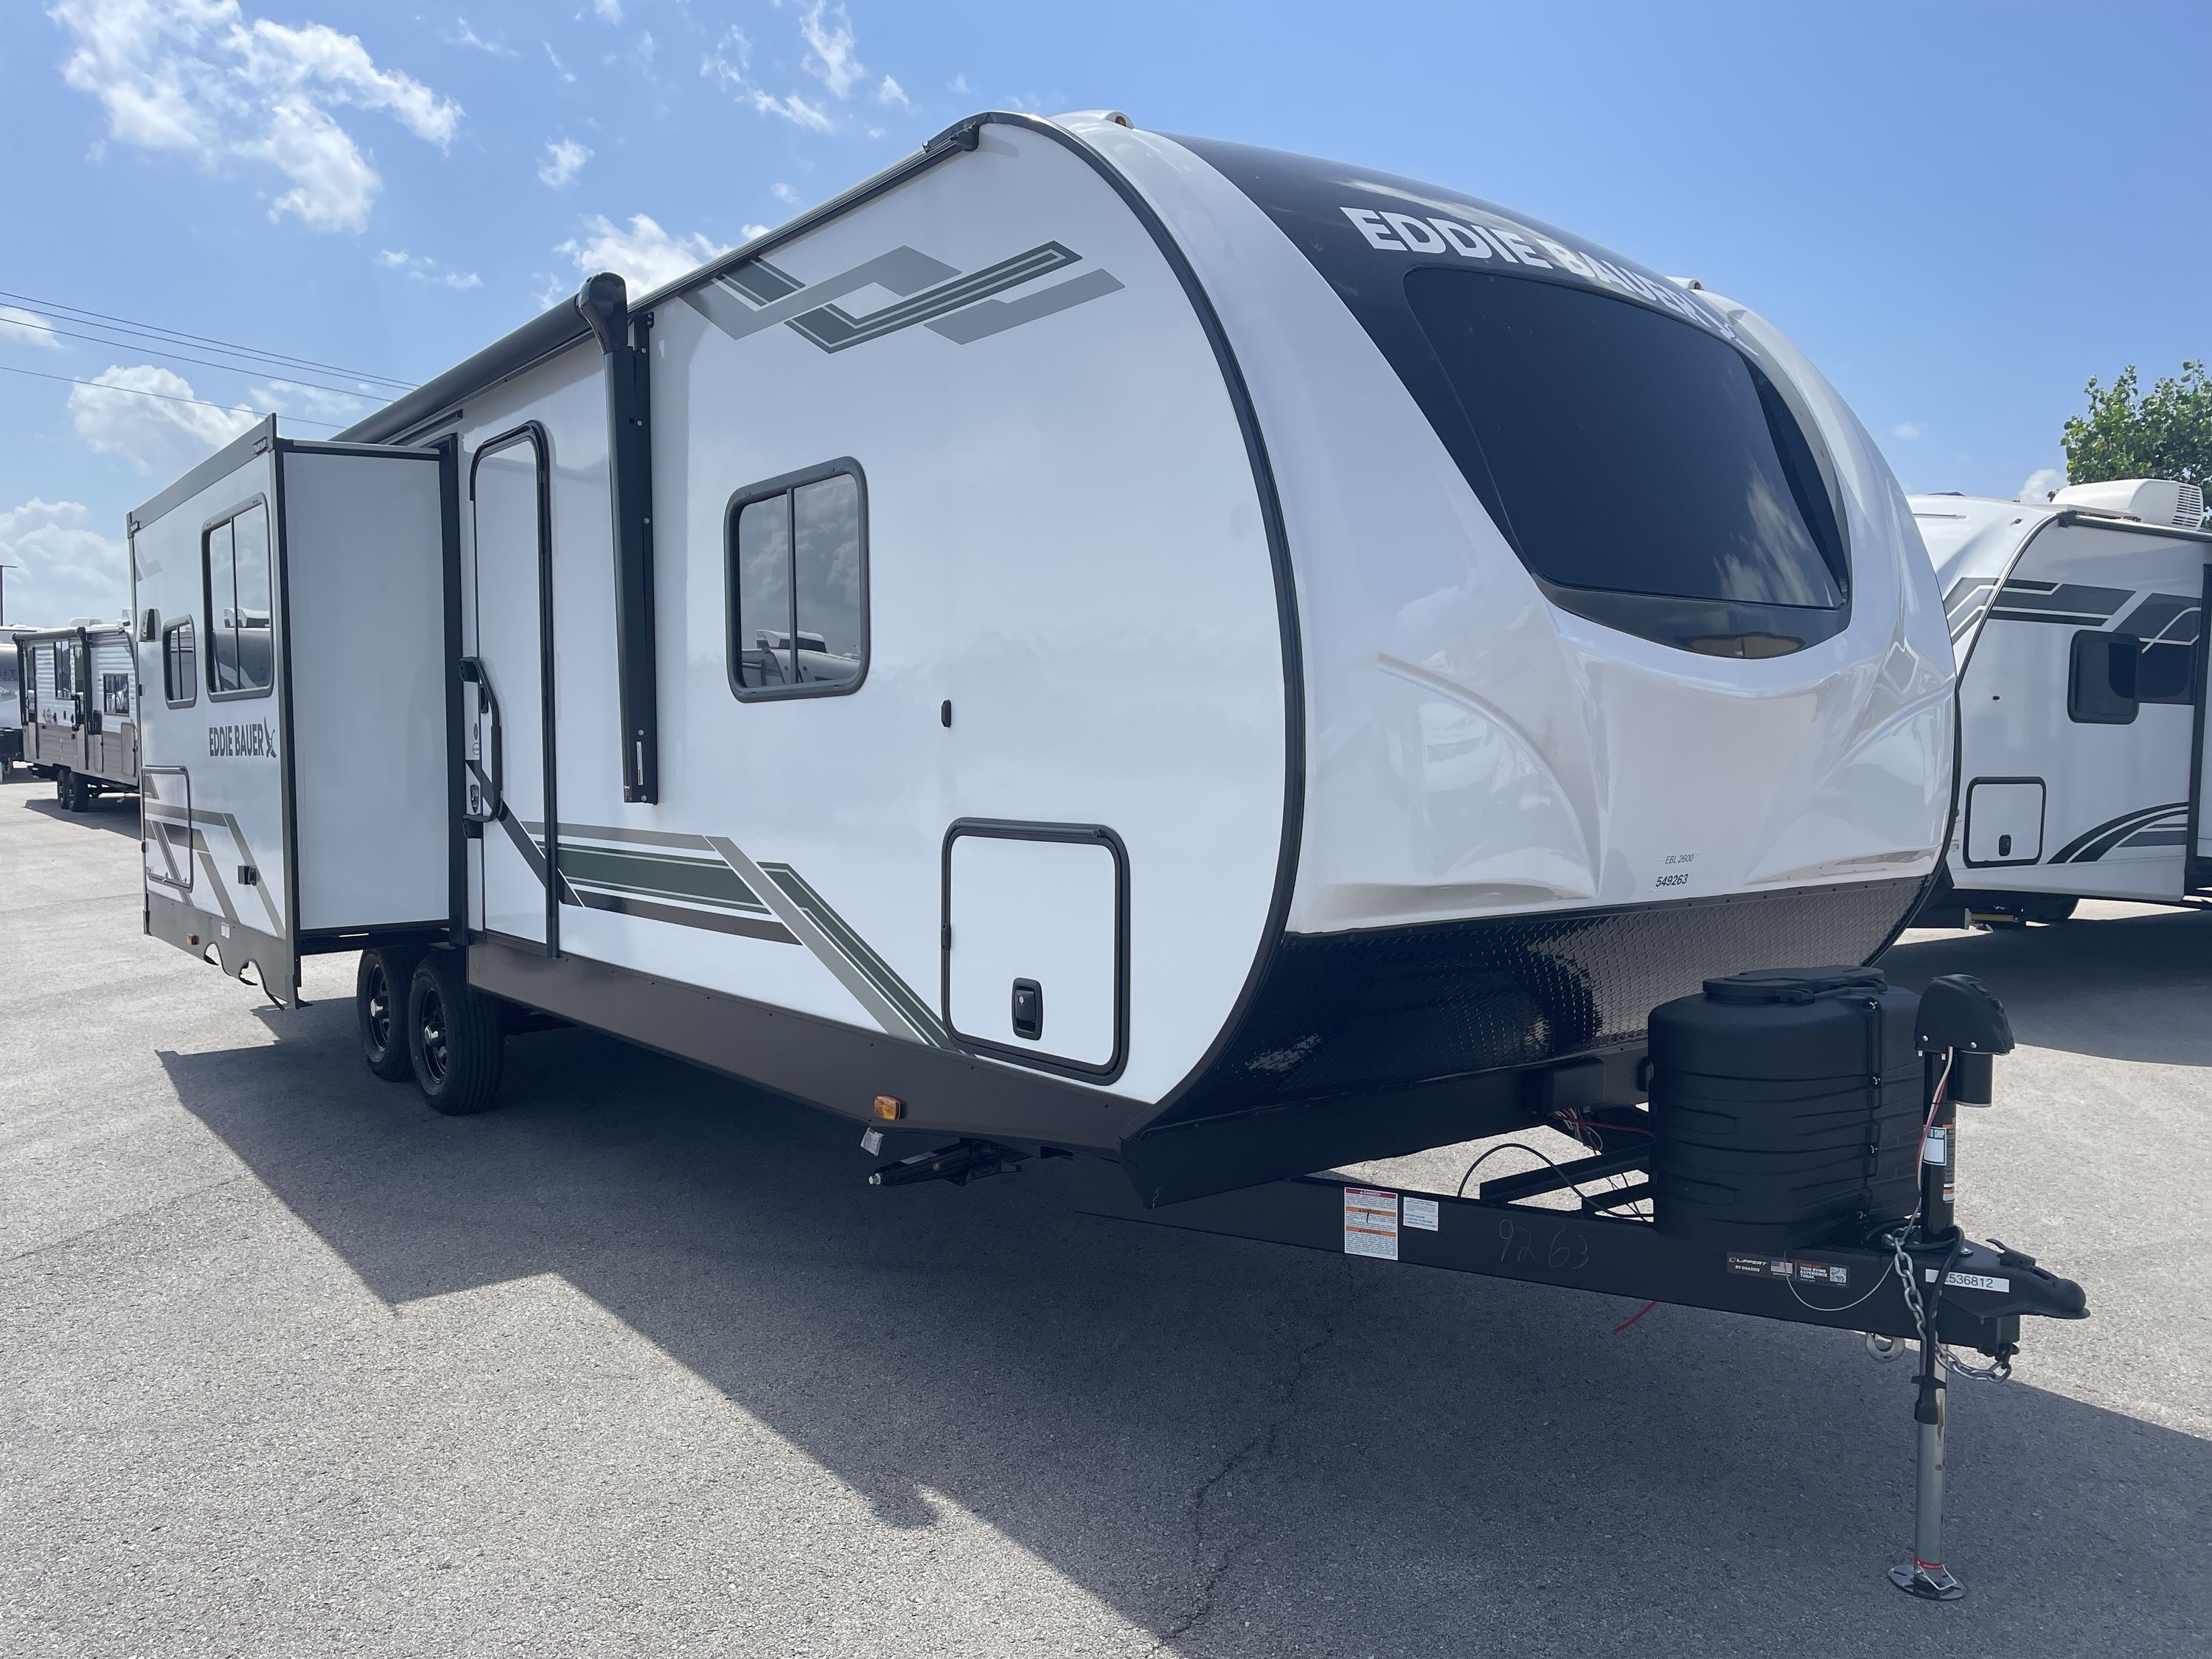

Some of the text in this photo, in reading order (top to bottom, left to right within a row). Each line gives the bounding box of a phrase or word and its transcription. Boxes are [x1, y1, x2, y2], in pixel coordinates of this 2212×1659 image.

[1339, 206, 1712, 329] EDDIE BAUER
[209, 723, 264, 757] EDDIE BAUER
[1665, 854, 1694, 864] EBL 2600
[1655, 874, 1688, 887] 549263
[1946, 1273, 1994, 1289] 536812
